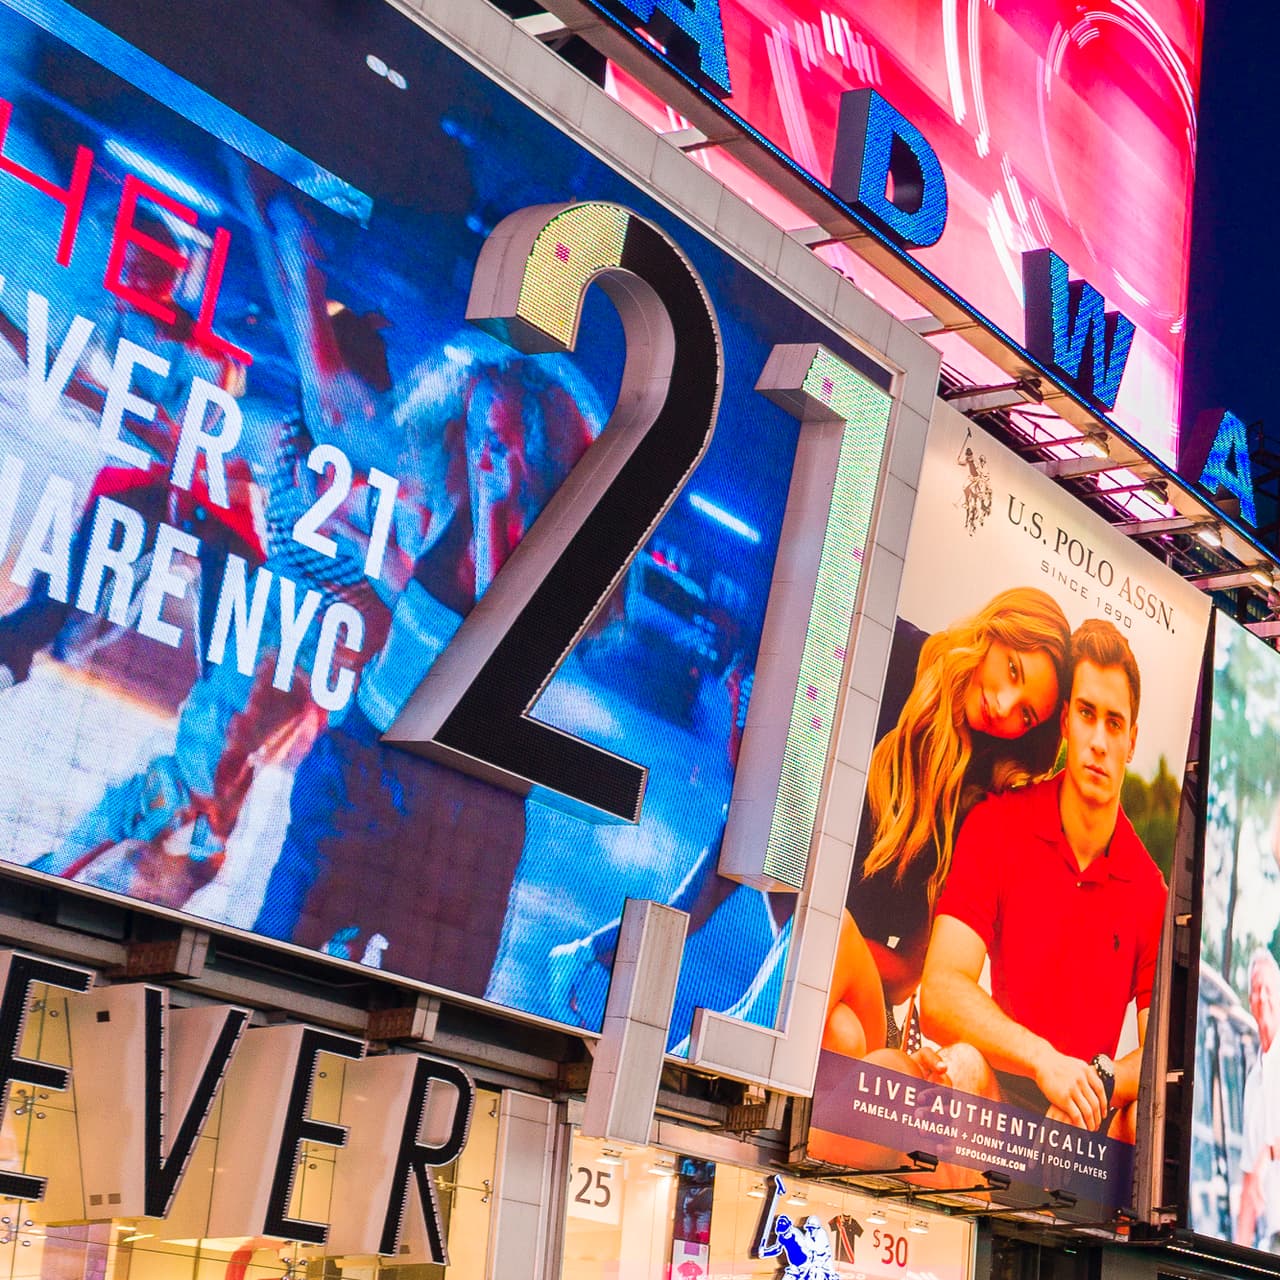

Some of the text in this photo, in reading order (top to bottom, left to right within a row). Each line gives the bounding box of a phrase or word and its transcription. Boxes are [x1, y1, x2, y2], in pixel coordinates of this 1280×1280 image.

[0, 272, 400, 581] VER 21
[0, 455, 366, 713] ARE NYC
[1007, 493, 1176, 635] U.S. POLO ASSN.
[1040, 559, 1133, 630] SINCE 1890
[853, 1099, 899, 1122] PAMELA
[901, 1113, 959, 1139] FLANAGAN
[970, 1132, 1005, 1153] JONNY
[1006, 1142, 1040, 1161] LAVINE
[1047, 1154, 1072, 1171] POLO
[1073, 1161, 1108, 1181] PLAYERS
[857, 1071, 1108, 1162] LIVE AUTHENTICALLY
[955, 1145, 1026, 1172] USPOLOASSN.COM
[873, 1228, 910, 1268] $30
